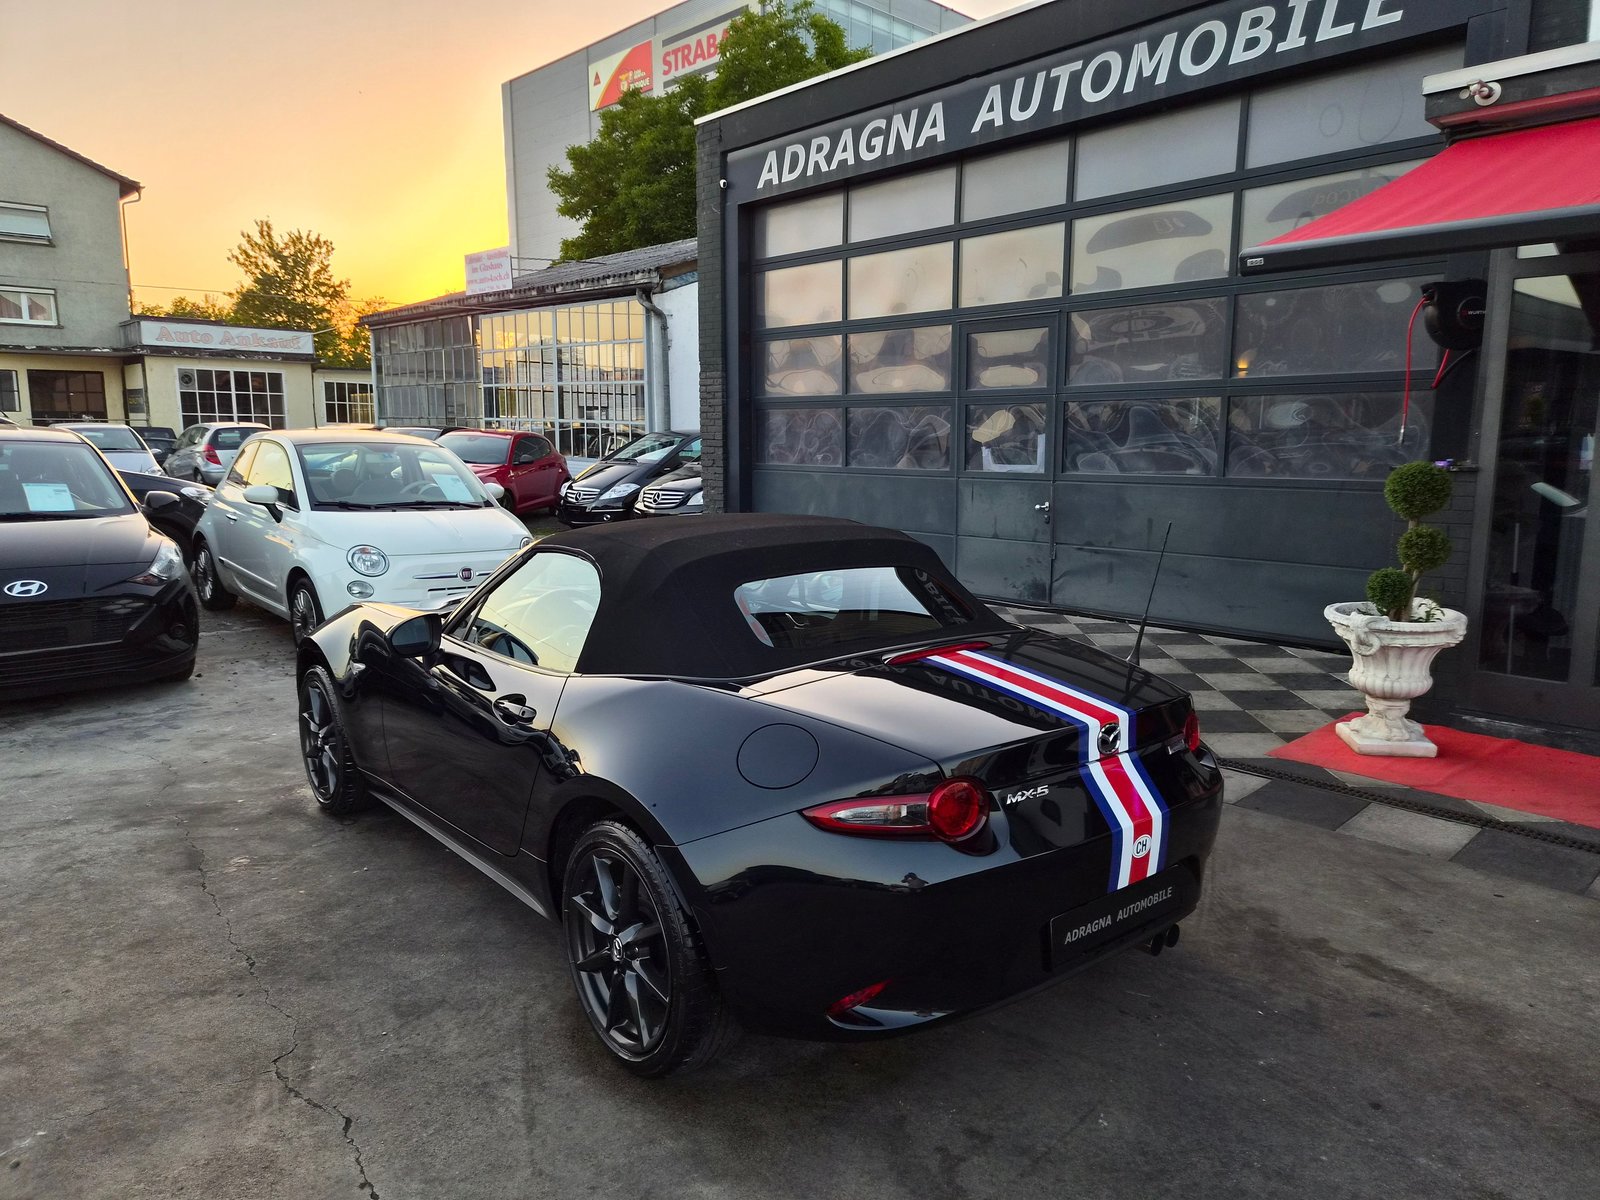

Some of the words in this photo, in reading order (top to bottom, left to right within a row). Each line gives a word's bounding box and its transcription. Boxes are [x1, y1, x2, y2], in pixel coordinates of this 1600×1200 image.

[756, 101, 946, 189] ADRAGNA
[970, 0, 1404, 134] AUTOMOBILE
[155, 325, 214, 345] Auto
[219, 330, 303, 350] Ankauf
[1006, 784, 1049, 805] MX-5
[1135, 840, 1147, 854] CH
[1064, 914, 1112, 945] ADRAGNA
[1116, 886, 1173, 922] AUTOMOBILE
